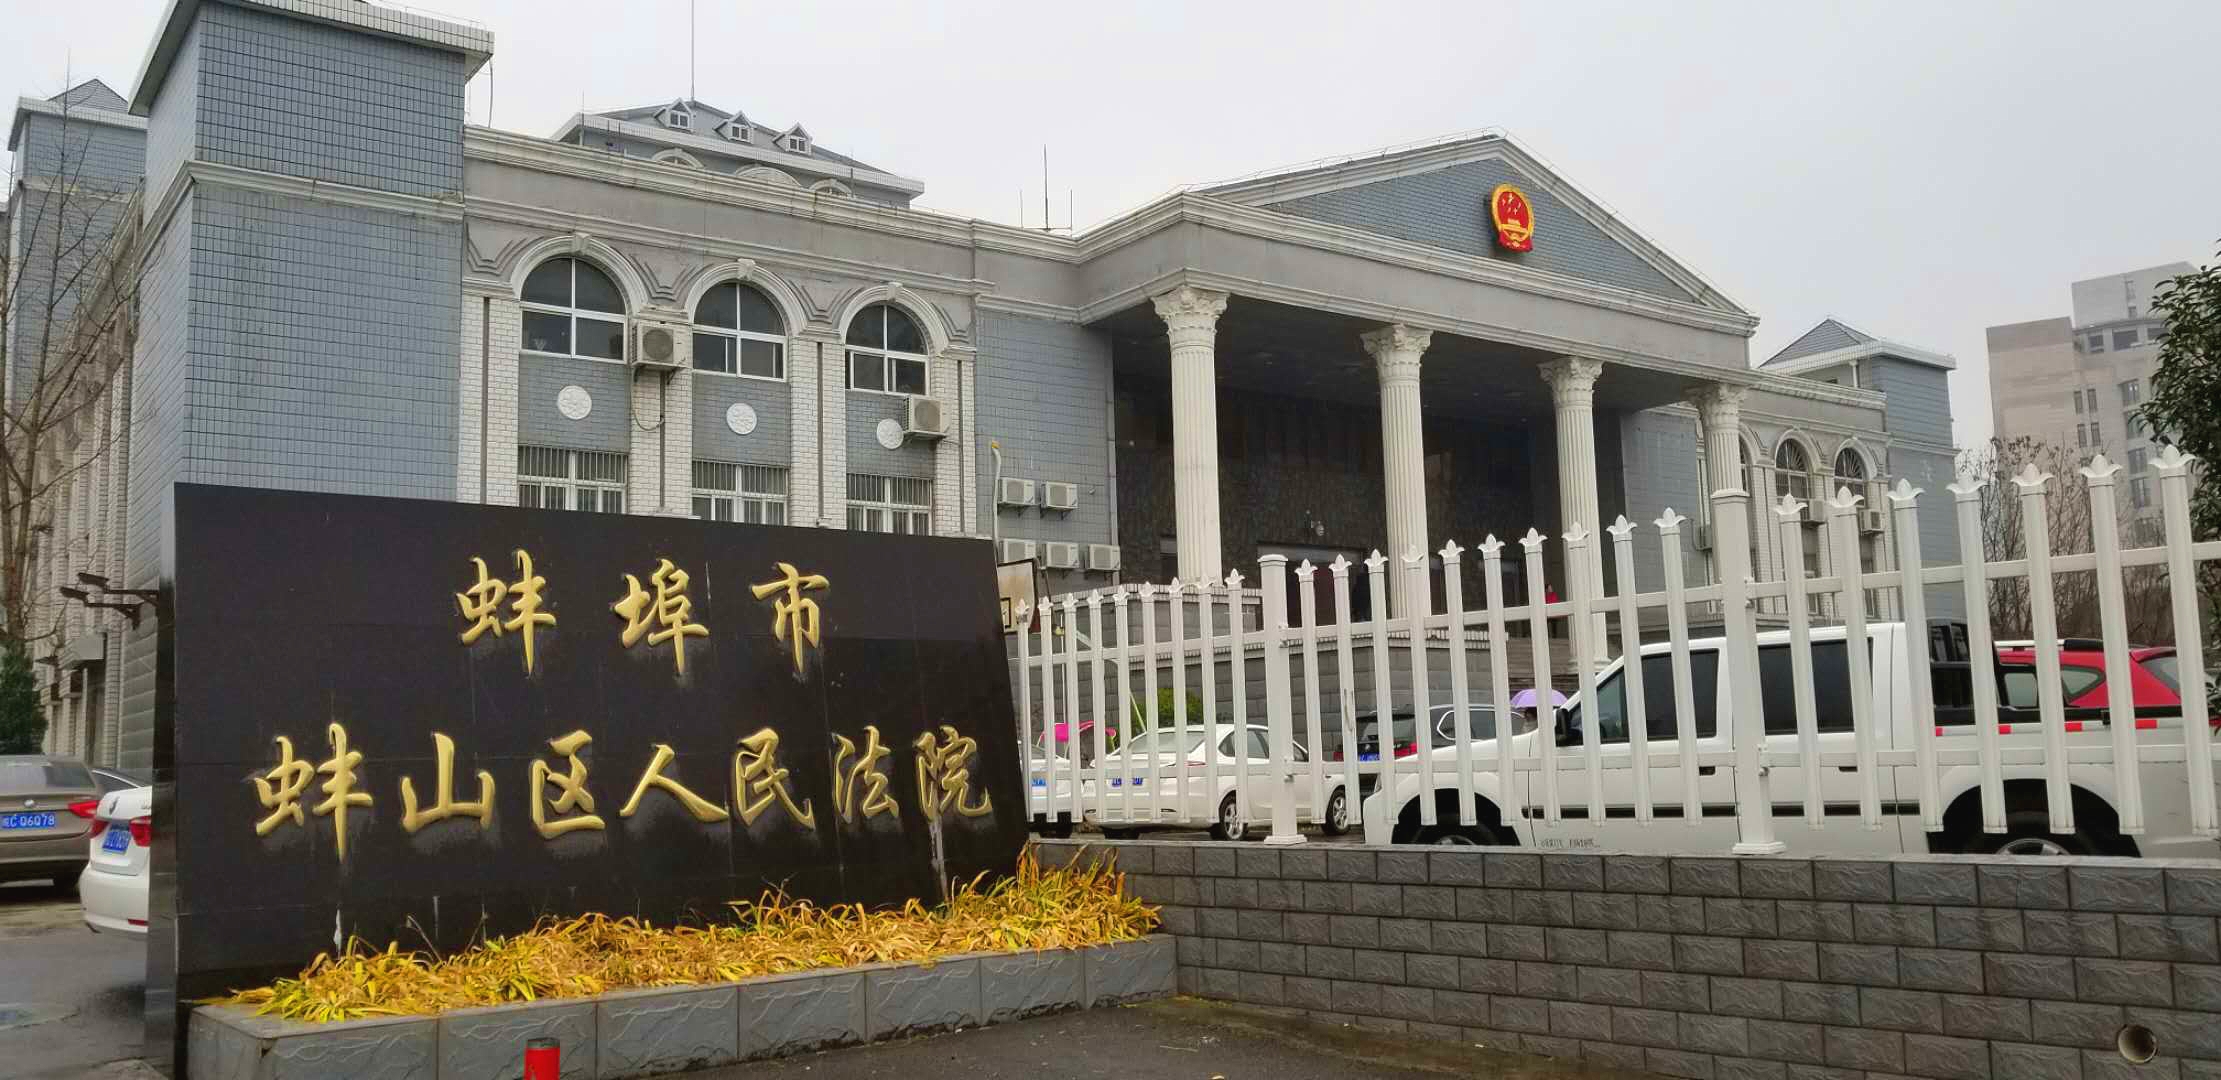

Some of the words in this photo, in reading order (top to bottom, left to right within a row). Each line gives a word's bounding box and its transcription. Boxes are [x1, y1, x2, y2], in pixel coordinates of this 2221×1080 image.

[456, 548, 829, 674] 蚌埠市
[254, 720, 993, 859] 蚌山区人民法院
